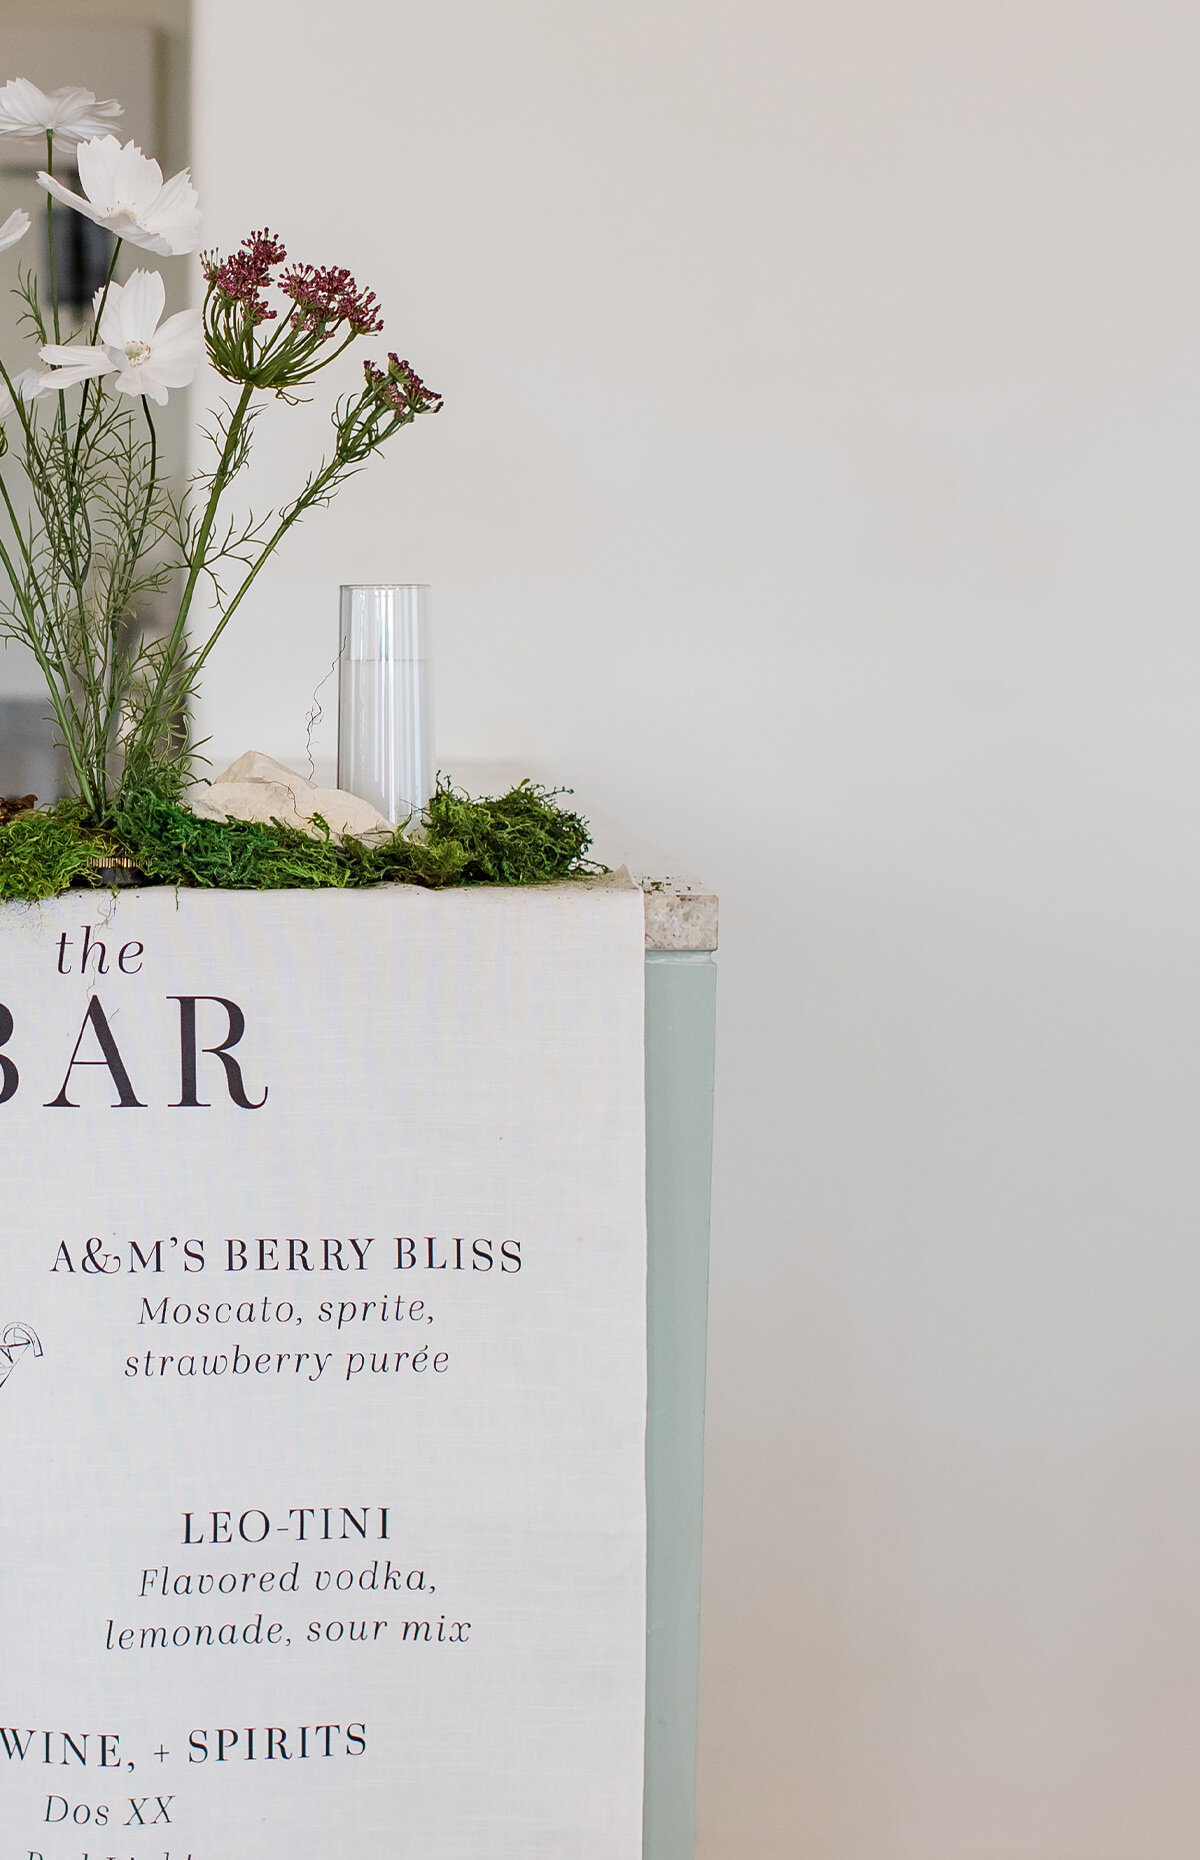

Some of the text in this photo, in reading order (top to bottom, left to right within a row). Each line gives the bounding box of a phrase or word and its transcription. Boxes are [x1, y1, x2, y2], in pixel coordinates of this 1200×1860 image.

[55, 925, 145, 975] the
[224, 1237, 376, 1272] BERRY
[392, 1236, 522, 1274] BLISS
[136, 1294, 434, 1331] Moscato, sprite,
[124, 1343, 449, 1382] strawberry purée
[180, 1506, 391, 1545] LEO-TINI
[137, 1559, 436, 1598] Flavored vodka,
[106, 1613, 472, 1651] lemonade, sour mix
[188, 1722, 366, 1764] SPIRITS
[43, 1794, 176, 1827] Dos XX
